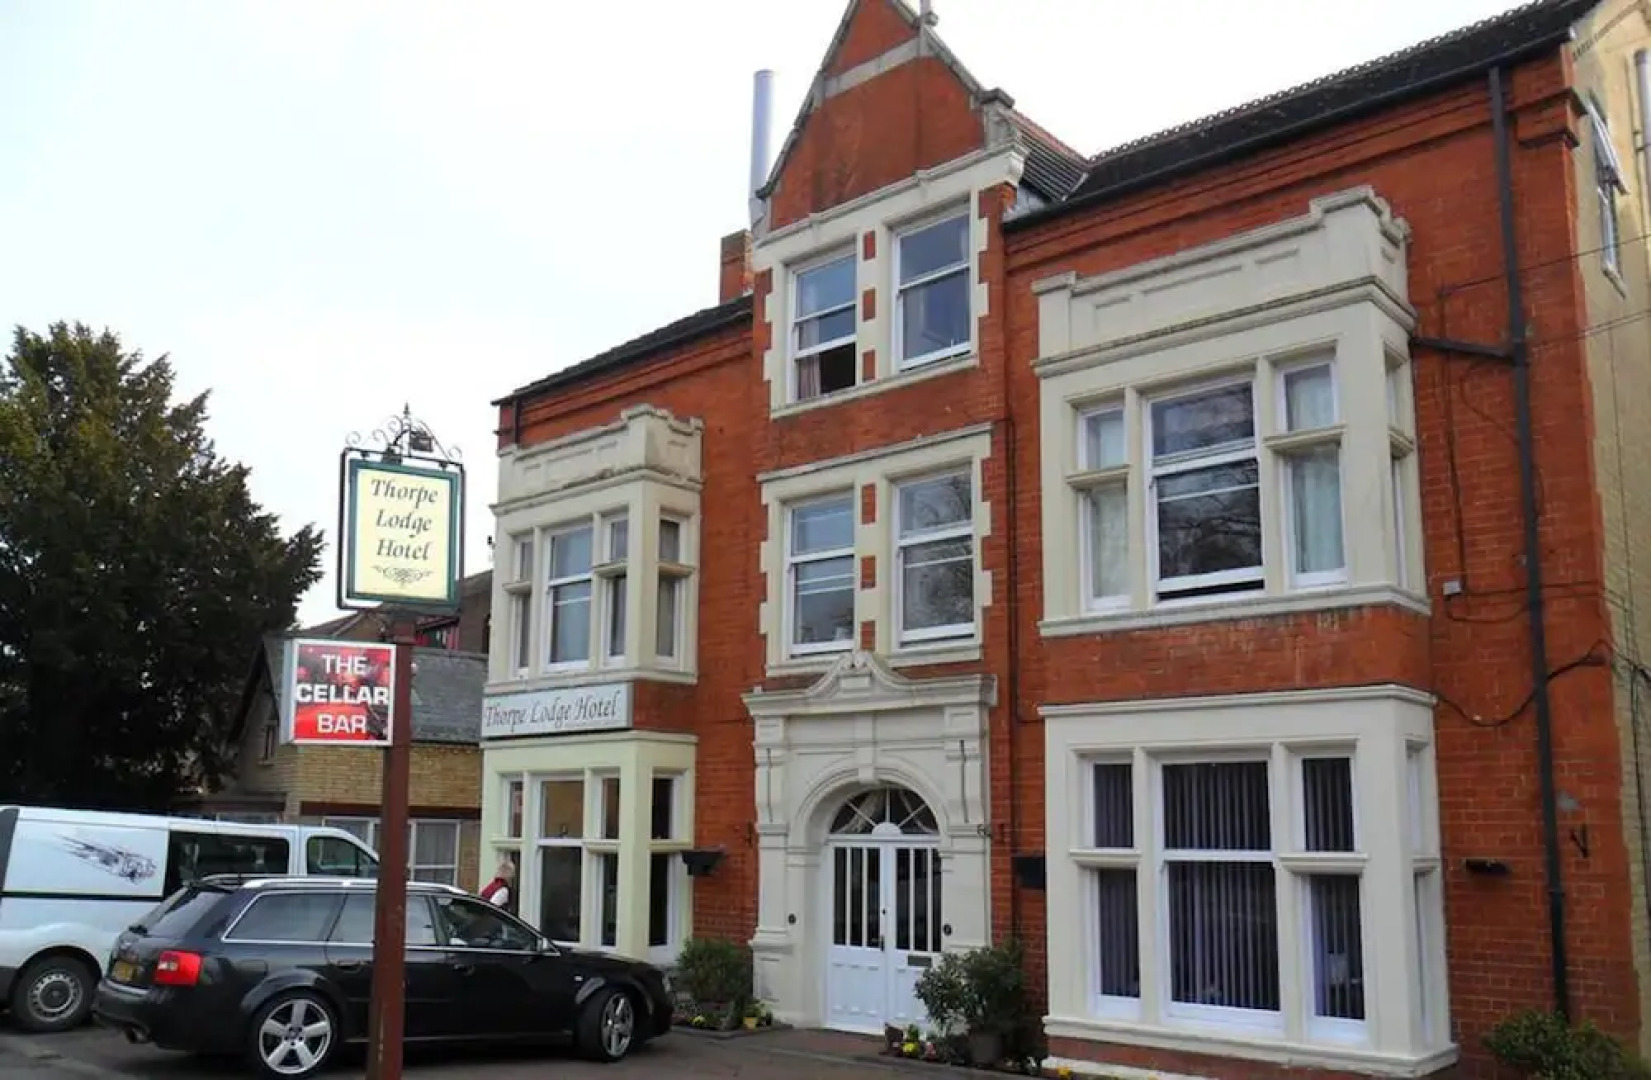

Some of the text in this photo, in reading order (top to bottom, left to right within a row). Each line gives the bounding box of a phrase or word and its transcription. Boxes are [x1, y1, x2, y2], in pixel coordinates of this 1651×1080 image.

[371, 478, 438, 509] Thorpe
[376, 508, 432, 538] Lodge
[377, 538, 432, 561] Hotel
[322, 654, 368, 676] THE
[297, 683, 389, 705] CELLAR
[485, 689, 621, 733] Thorpe Lodge Hotel
[317, 713, 366, 734] BAR
